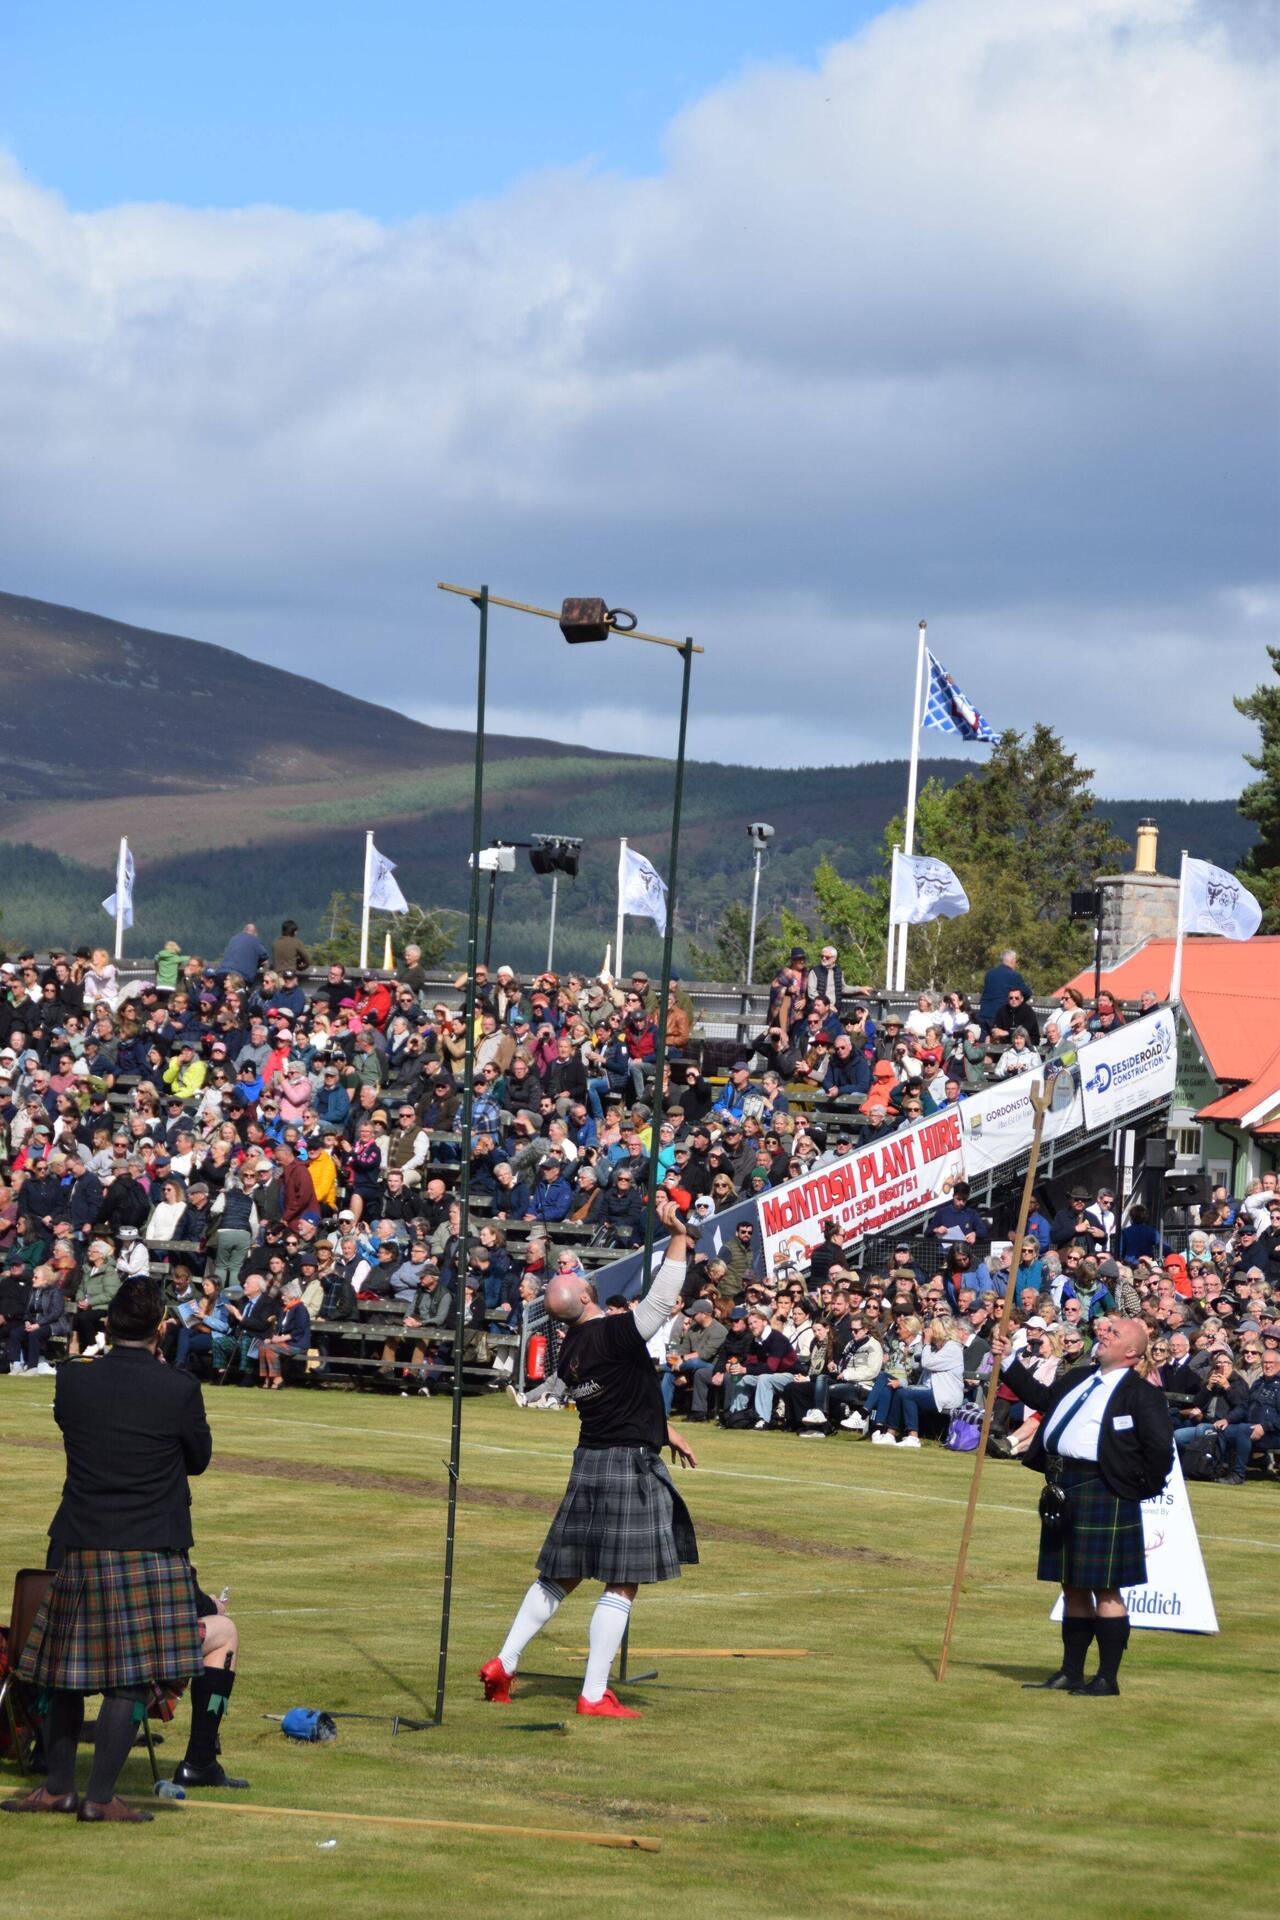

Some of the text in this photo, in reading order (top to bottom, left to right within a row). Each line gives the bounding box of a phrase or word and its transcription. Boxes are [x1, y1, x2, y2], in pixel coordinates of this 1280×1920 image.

[986, 1096, 1031, 1122] GORDONSTO
[762, 1113, 962, 1237] McINTOSH PLANT HIRE
[842, 1194, 876, 1222] 01330
[879, 1175, 918, 1206] 860751
[1126, 1590, 1181, 1615] fiddich
